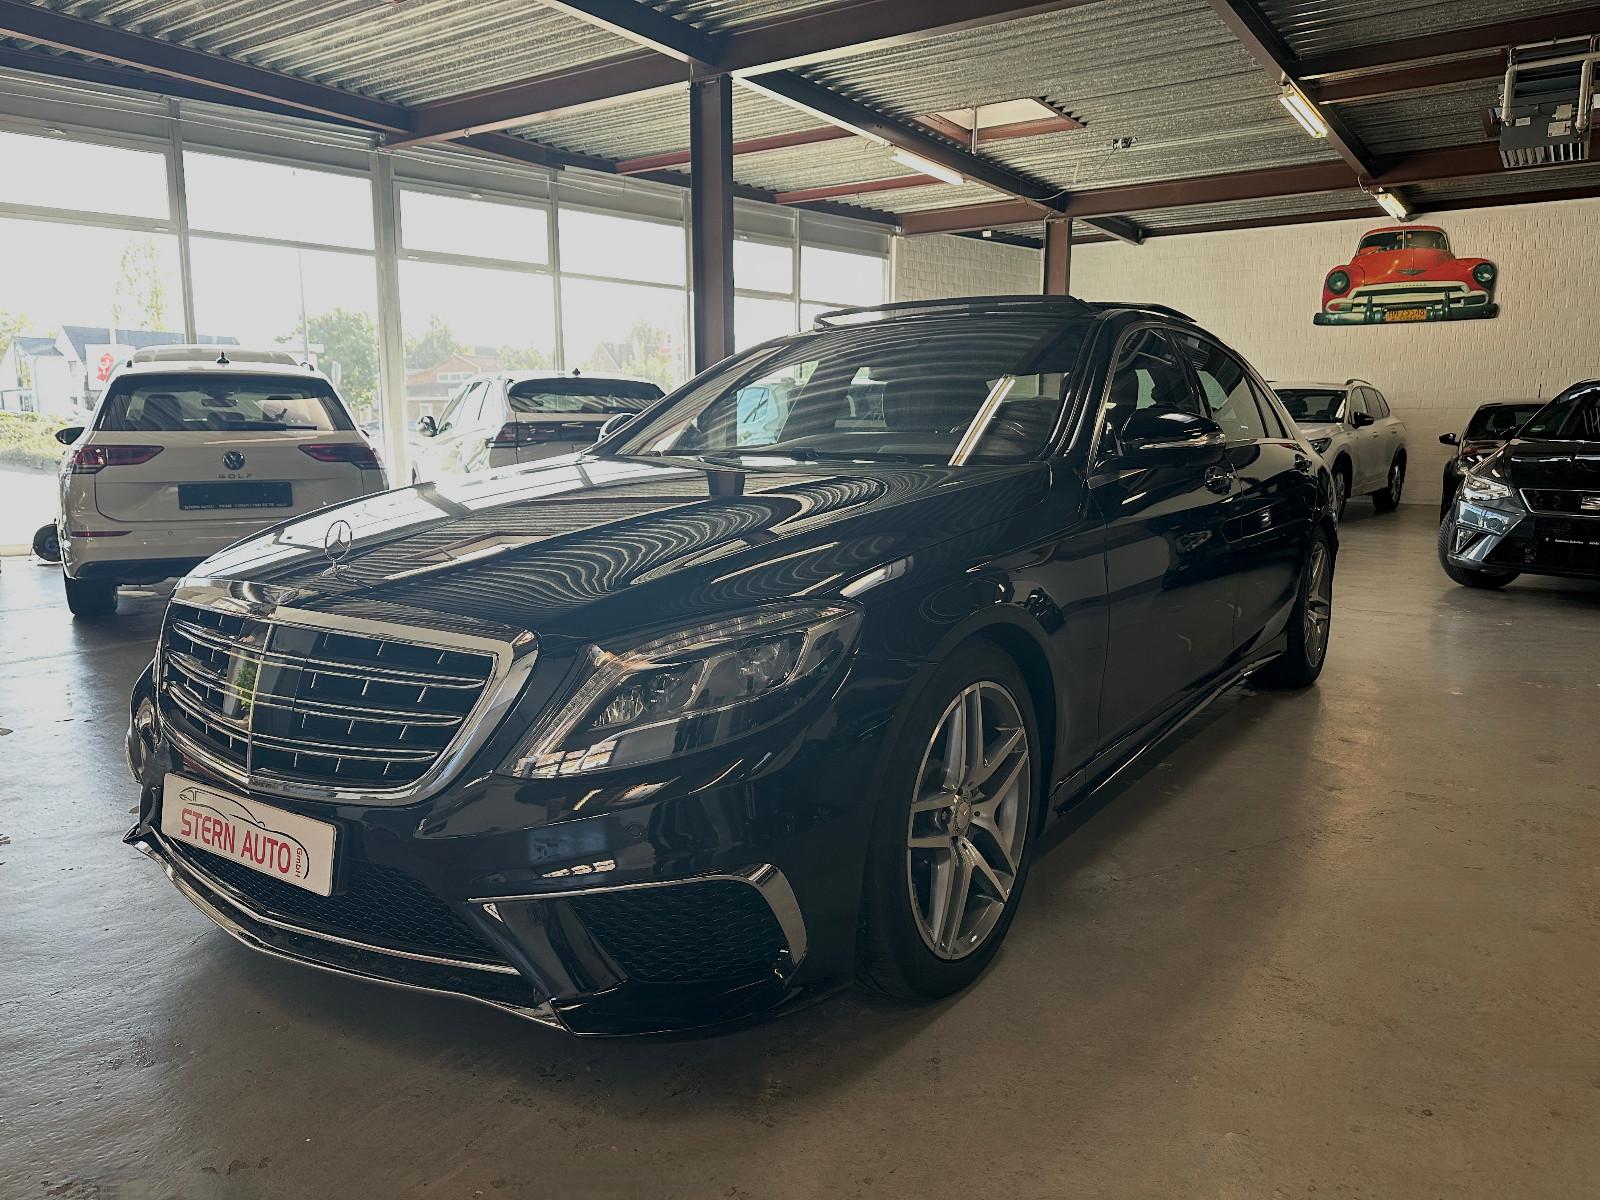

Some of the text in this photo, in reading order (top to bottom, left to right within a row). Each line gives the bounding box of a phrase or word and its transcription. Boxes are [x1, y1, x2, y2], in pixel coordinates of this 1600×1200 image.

[181, 807, 291, 873] STERN AUTO
[295, 847, 303, 877] GmbH
